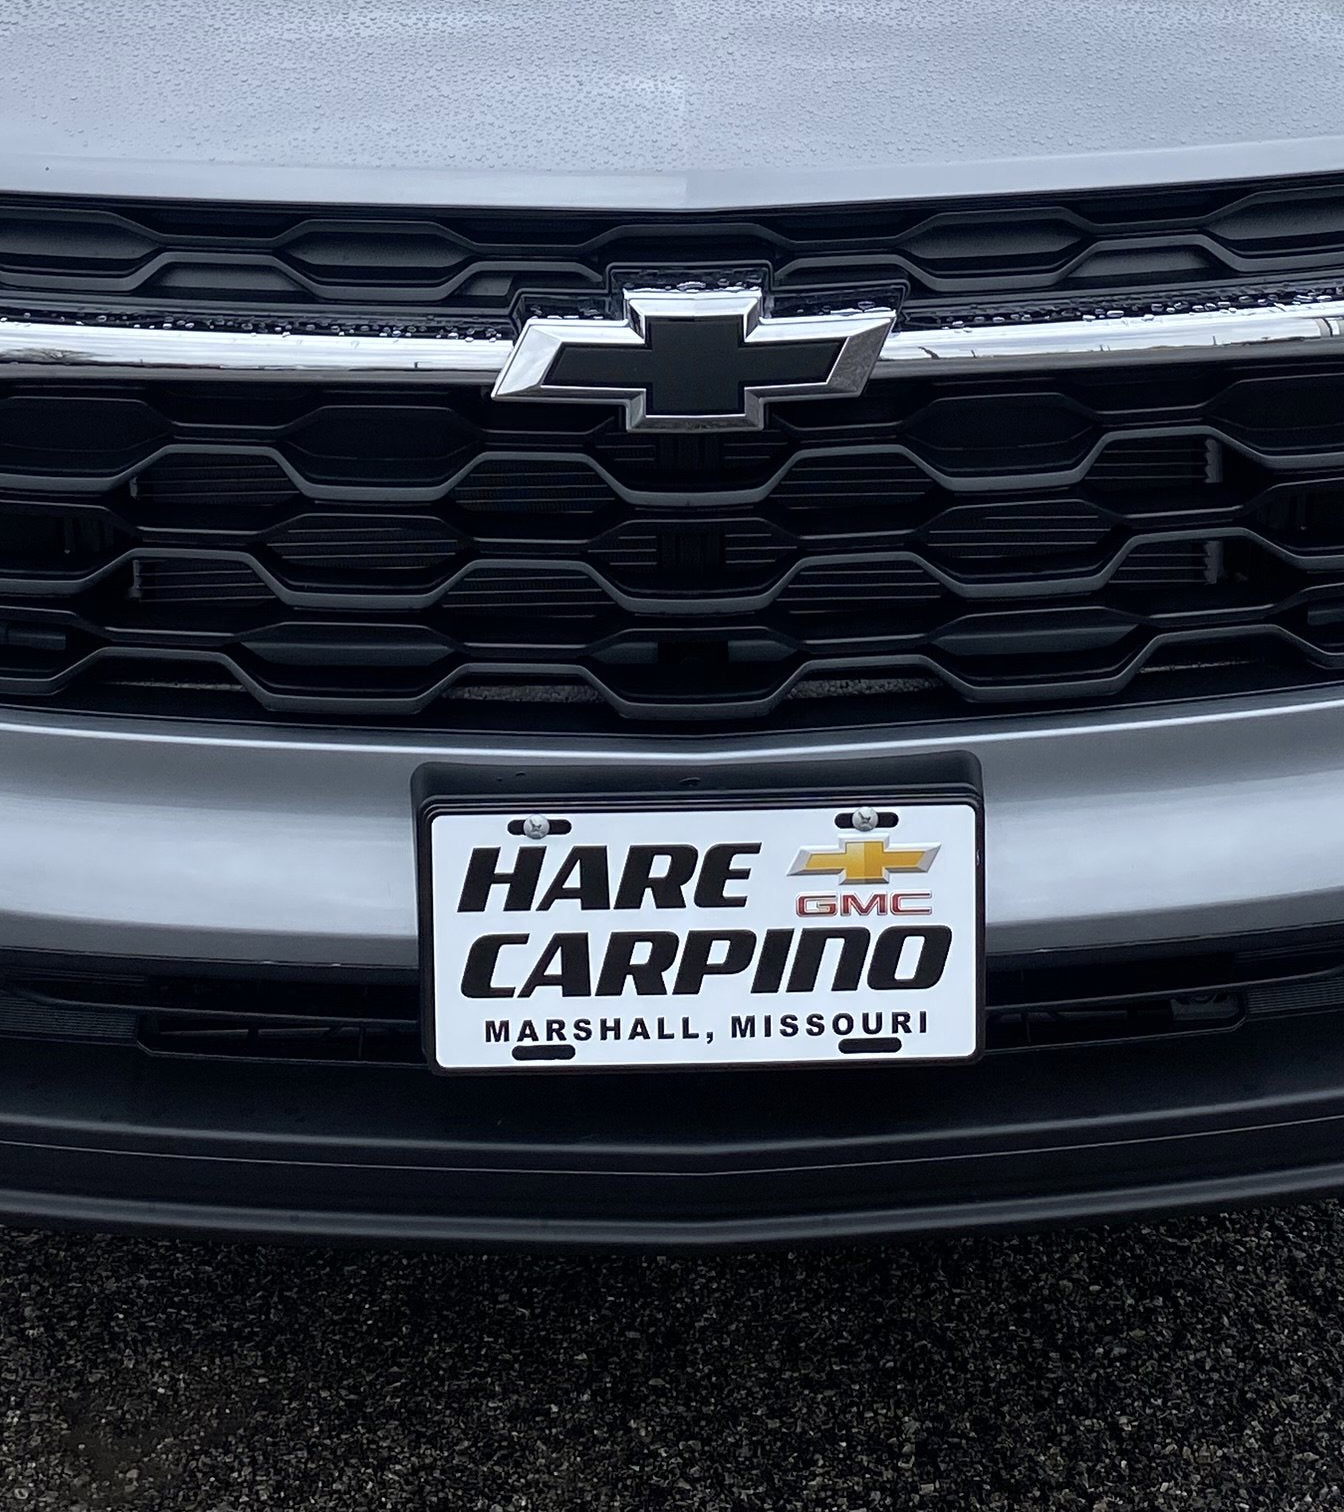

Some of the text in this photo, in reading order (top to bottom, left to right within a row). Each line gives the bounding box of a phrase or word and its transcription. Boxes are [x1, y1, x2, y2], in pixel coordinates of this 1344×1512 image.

[456, 841, 763, 913] HARE
[795, 889, 934, 918] GMC
[459, 924, 953, 1000] CARPINO
[484, 1010, 929, 1045] MARSHALL, MISSOURI
